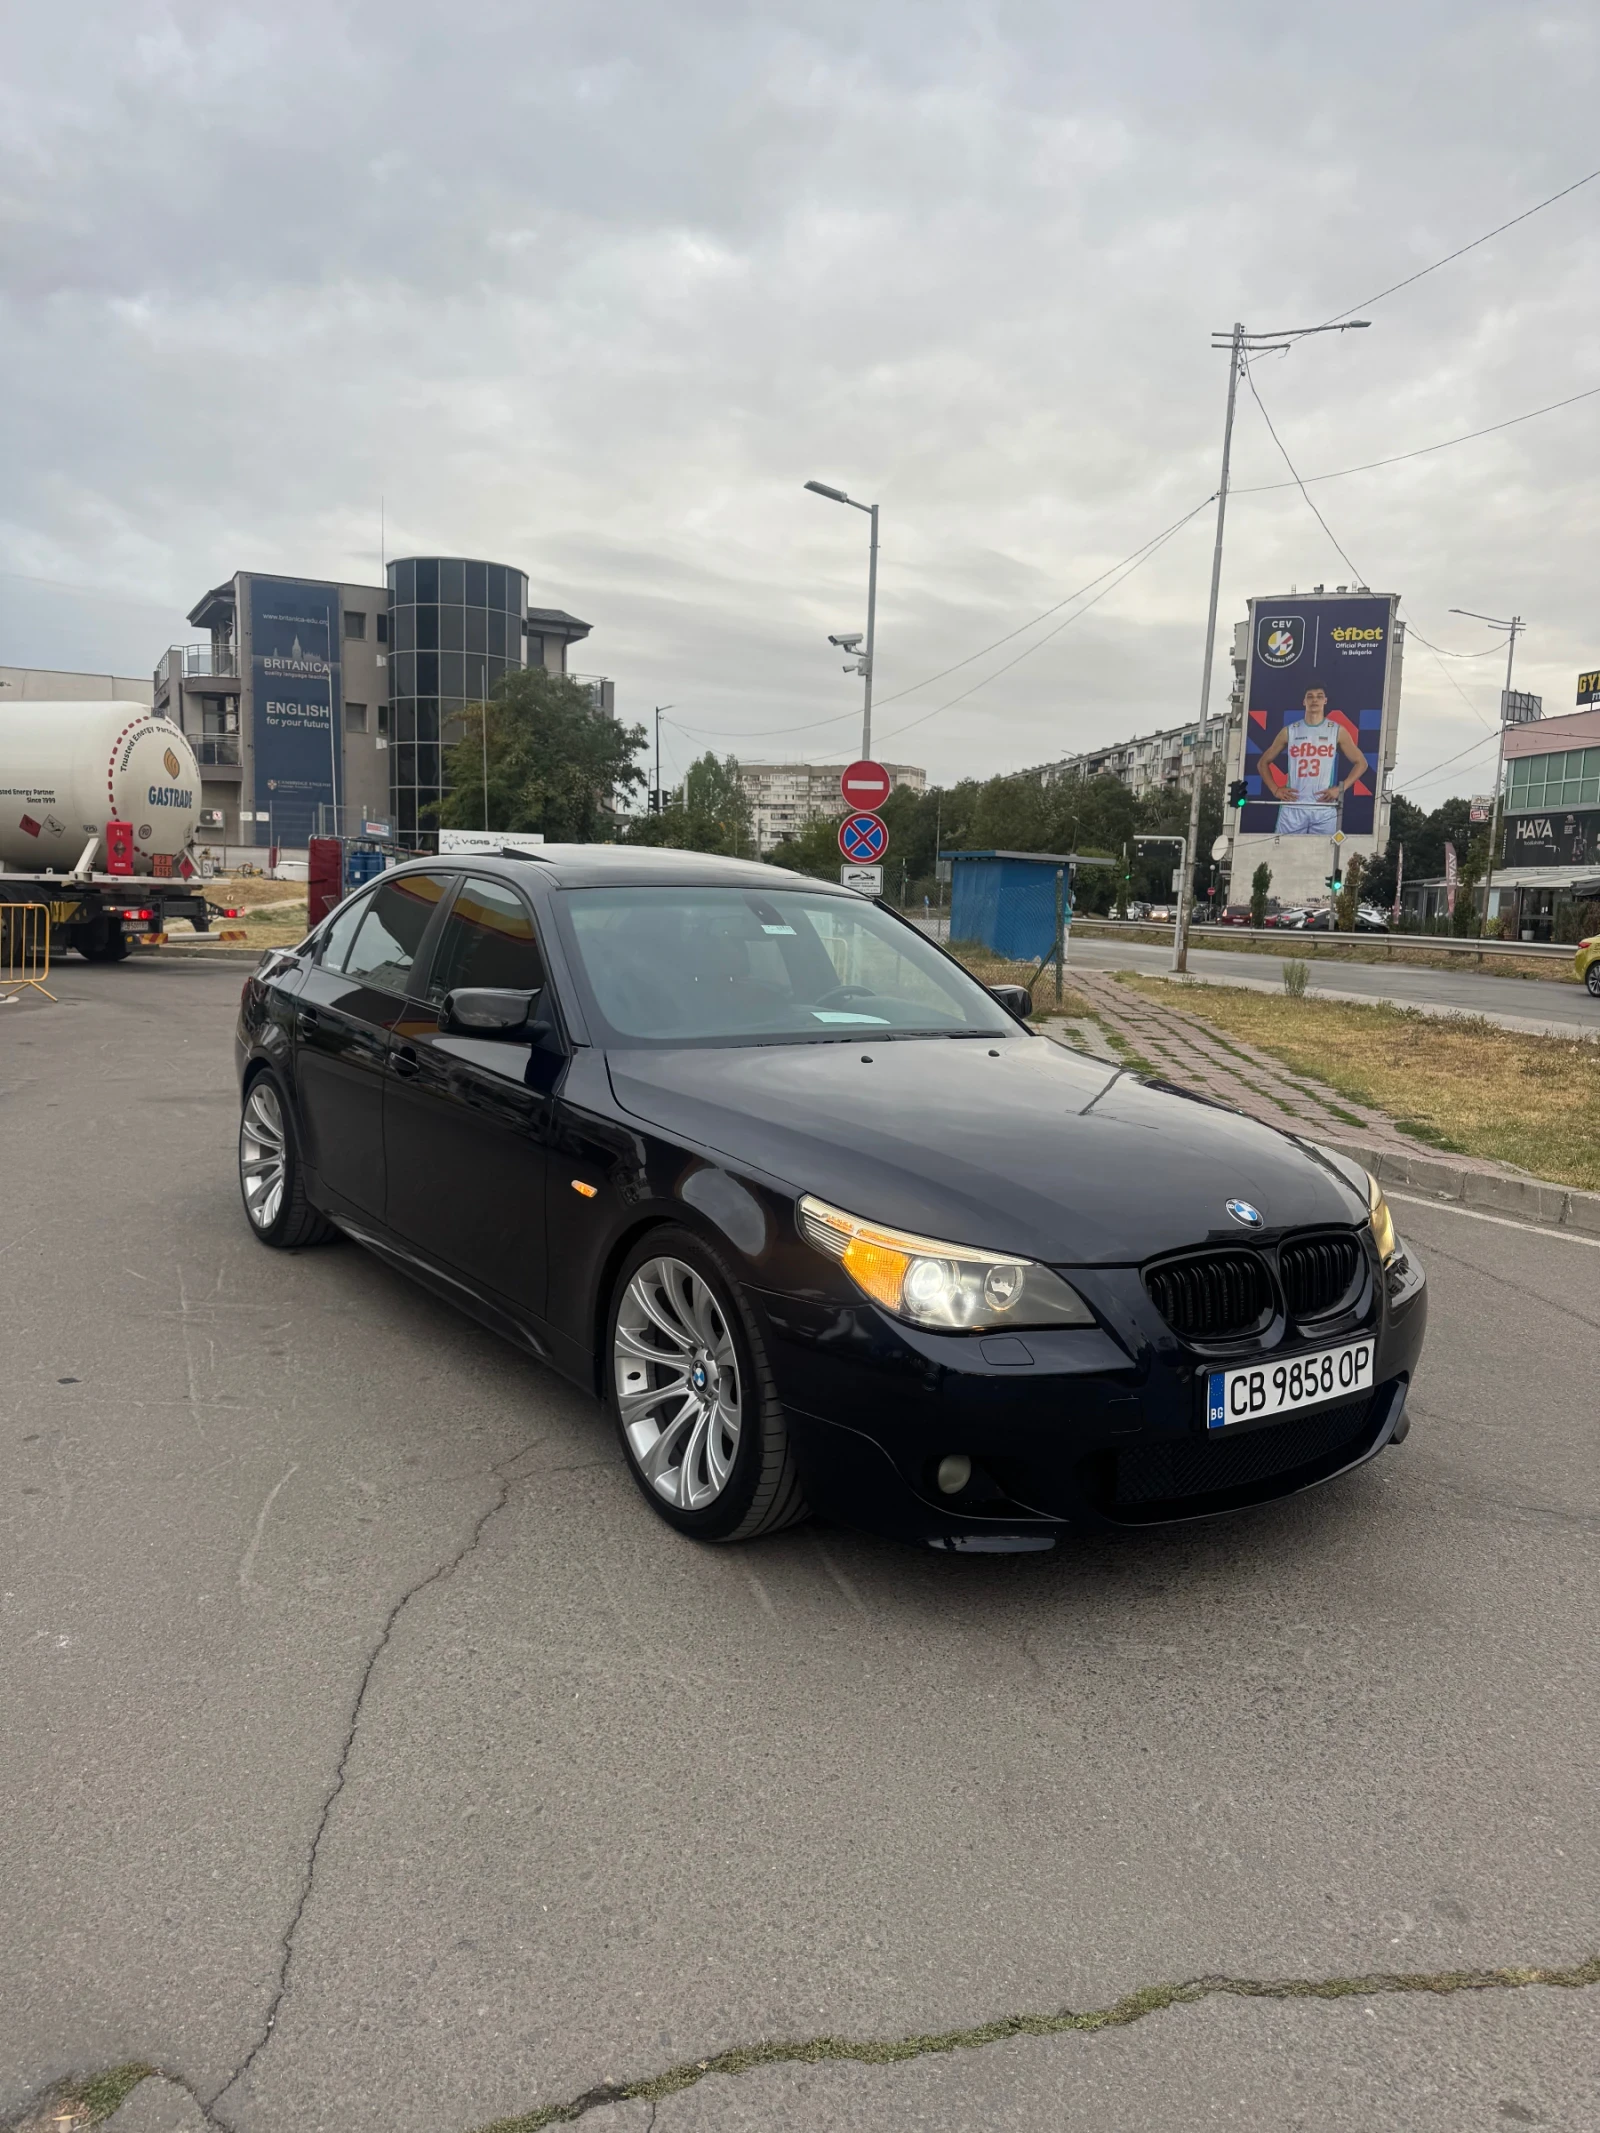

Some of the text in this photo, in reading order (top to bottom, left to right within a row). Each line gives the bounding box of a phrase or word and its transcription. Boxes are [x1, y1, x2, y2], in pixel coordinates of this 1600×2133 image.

[1271, 620, 1293, 629] CEV
[1331, 626, 1384, 641] efbet
[263, 658, 330, 673] BRITANICA
[266, 701, 329, 718] ENGLISH
[266, 716, 329, 729] for your future
[120, 739, 135, 772] Trusted
[132, 726, 155, 742] Energy
[1289, 742, 1334, 758] efbet
[1298, 759, 1320, 778] 23
[148, 786, 193, 809] GASTRADE
[1516, 819, 1553, 840] HAVA
[203, 863, 213, 874] SV
[1230, 1346, 1369, 1416] CB 9858 OP
[1211, 1406, 1224, 1420] BG
